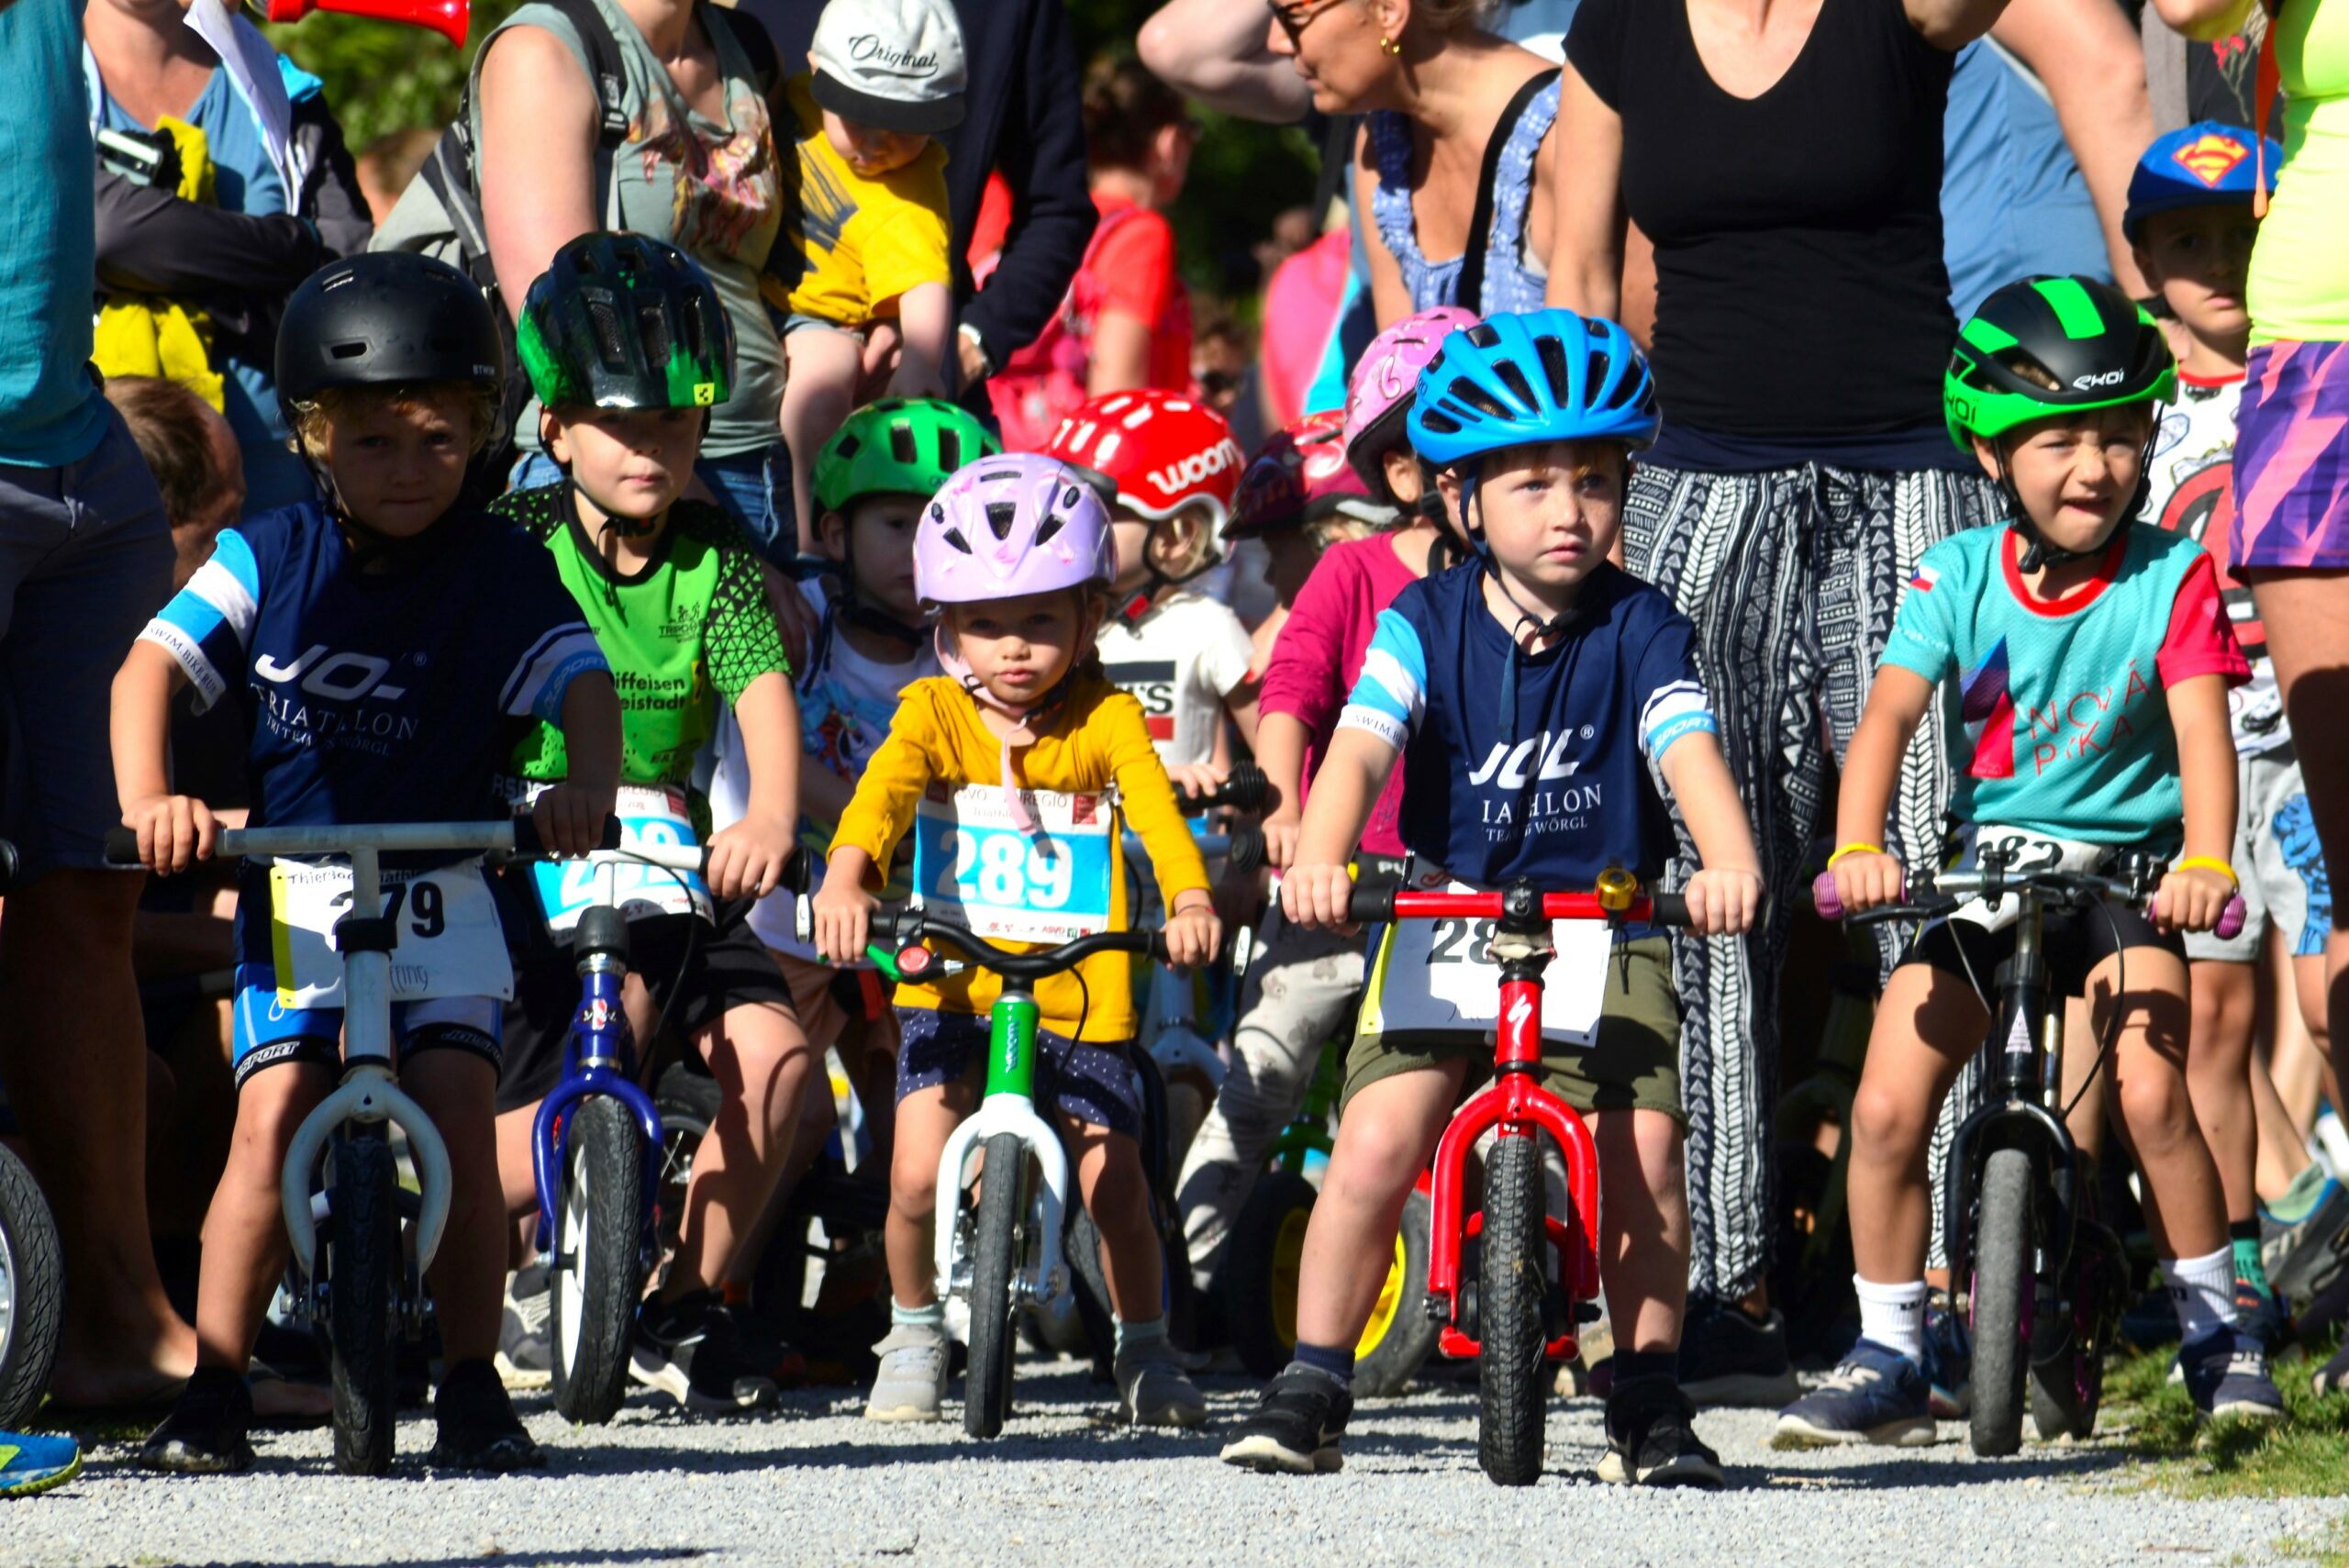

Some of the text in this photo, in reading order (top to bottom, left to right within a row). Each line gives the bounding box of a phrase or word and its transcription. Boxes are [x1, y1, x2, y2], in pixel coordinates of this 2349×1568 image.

[849, 34, 938, 72] Original
[1147, 438, 1246, 495] woom
[615, 672, 685, 691] iffeisen
[620, 693, 687, 710] eistadt
[1466, 728, 1580, 790] JOL
[1482, 784, 1601, 824] IAHLON
[1535, 815, 1588, 835] WÖRGL
[935, 828, 1074, 909] 289
[1425, 917, 1499, 965] 28
